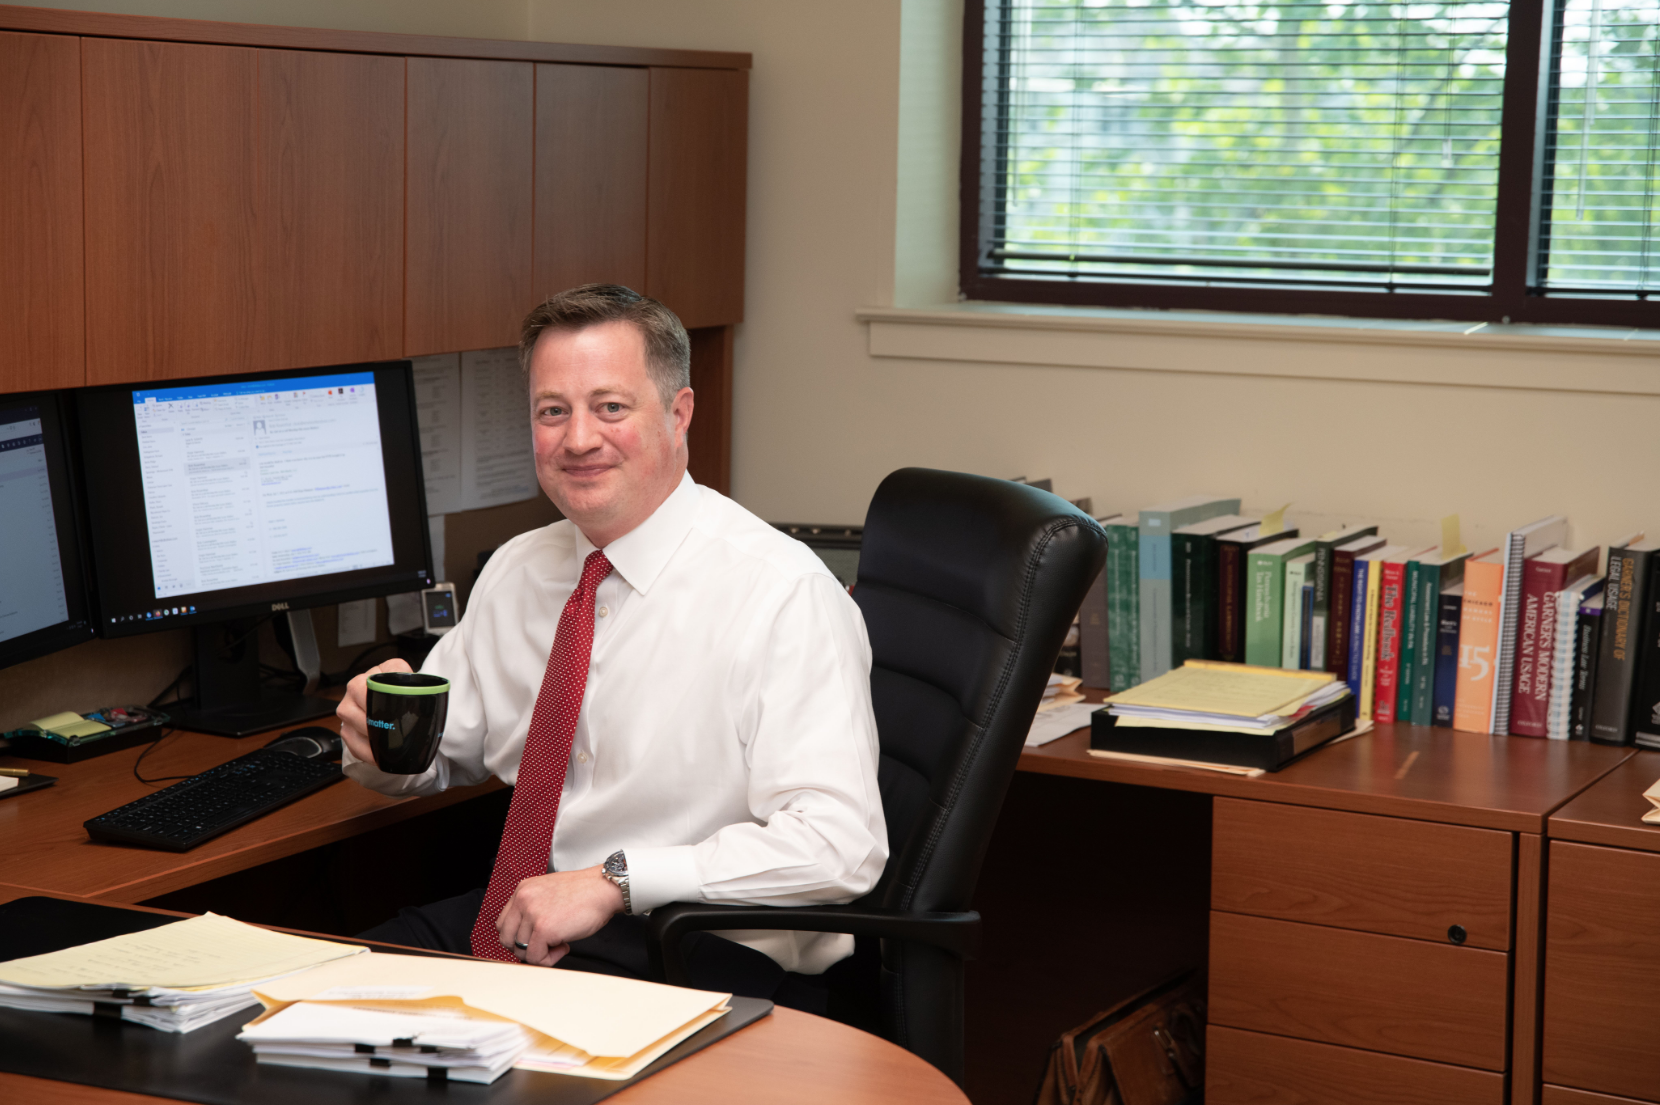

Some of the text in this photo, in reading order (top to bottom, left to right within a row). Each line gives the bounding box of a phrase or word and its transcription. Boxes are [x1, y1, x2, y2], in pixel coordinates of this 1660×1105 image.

[1316, 548, 1326, 602] PENNSYLVANIA
[1410, 570, 1419, 604] MUNICIPAL
[1608, 556, 1621, 581] LEGAL
[271, 602, 290, 611] DELL
[1255, 584, 1264, 622] Handbook
[1263, 571, 1272, 618] Pennsylvania
[1384, 583, 1399, 608] The
[1462, 598, 1493, 607] CHICAGO
[1606, 582, 1620, 611] USAGE
[1613, 557, 1634, 661] GARNER'S DICTIONARY OF
[1381, 609, 1397, 662] Redbook
[1408, 604, 1416, 632] LIABILITY
[1458, 643, 1491, 681] 15
[1518, 593, 1539, 695] AMERICAN USAGE
[1535, 591, 1555, 701] GARNER'S MODERN
[1579, 624, 1592, 690] Business Law Terms
[368, 718, 396, 730] matter.
